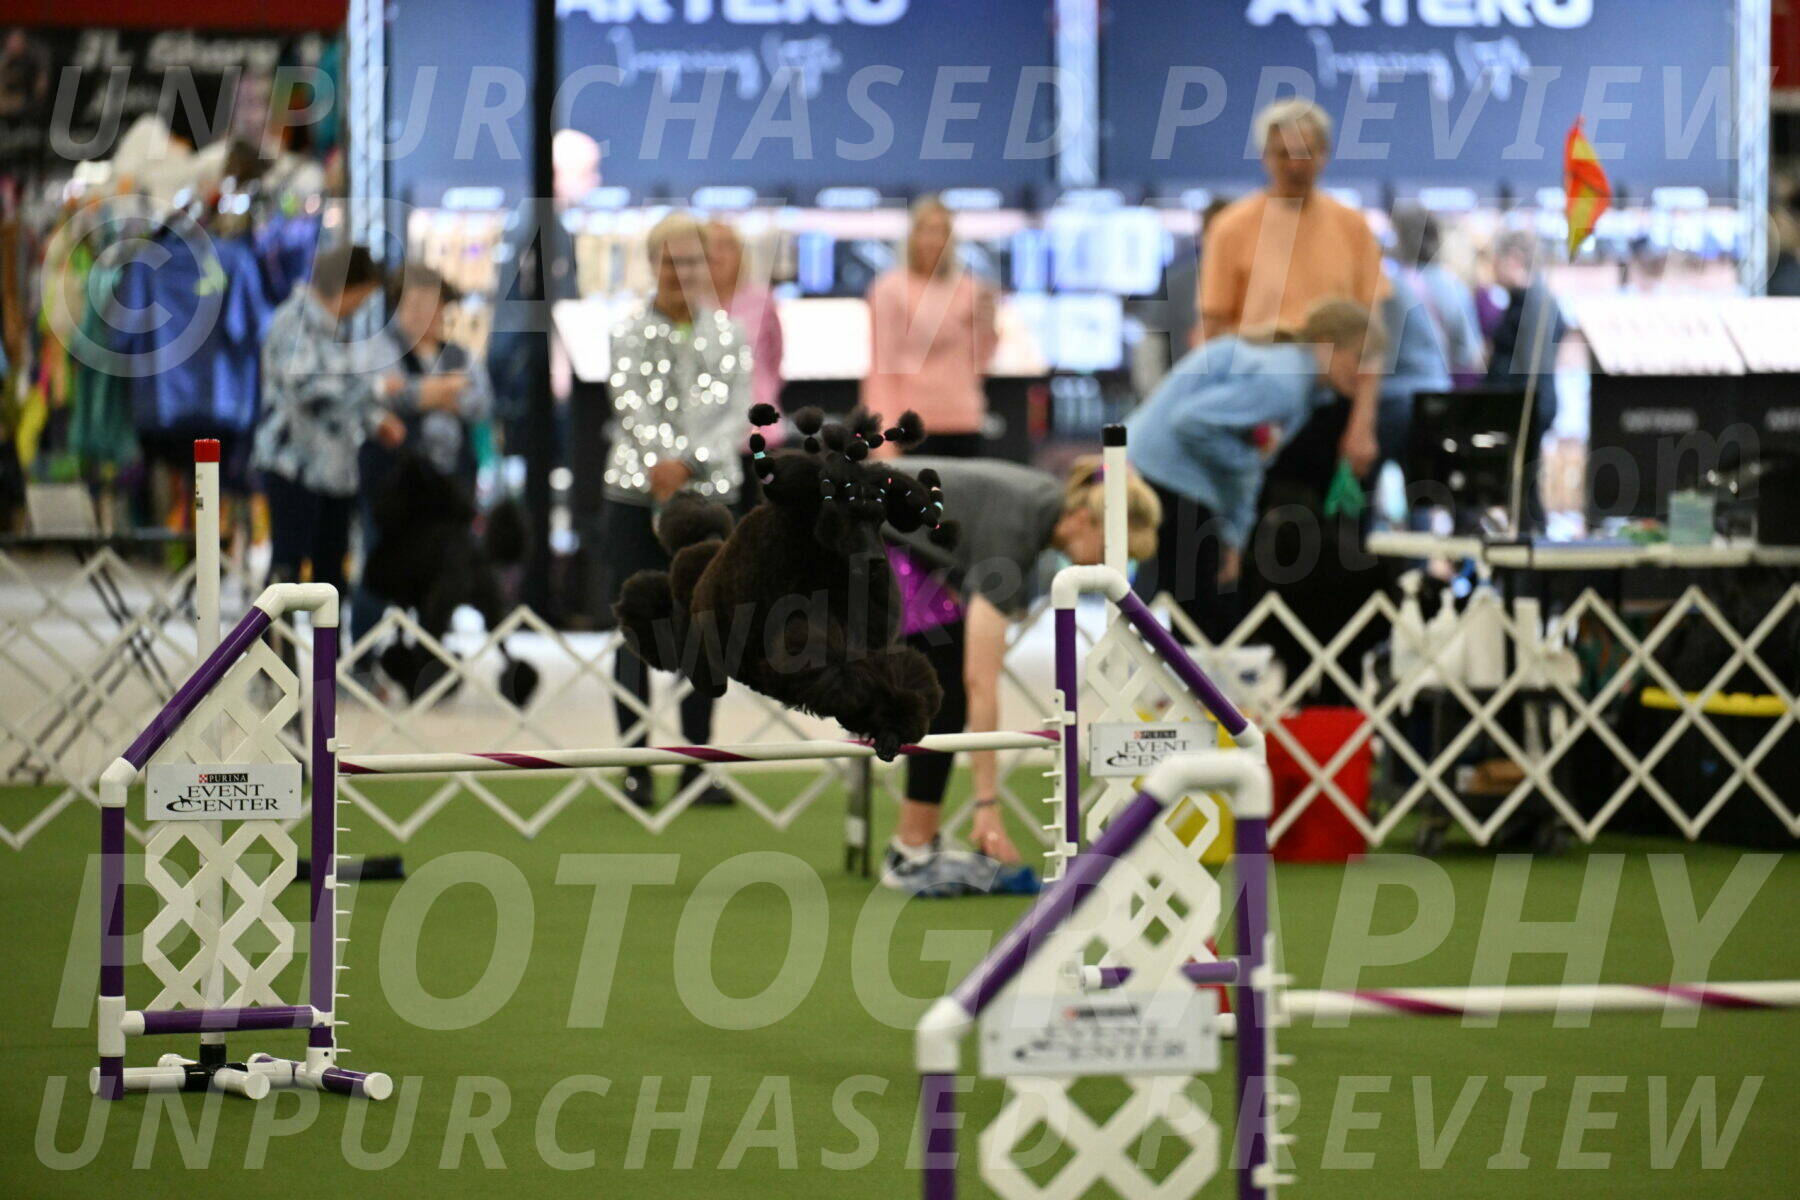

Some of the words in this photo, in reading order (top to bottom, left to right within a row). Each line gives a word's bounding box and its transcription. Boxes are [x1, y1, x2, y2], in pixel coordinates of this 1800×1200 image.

[1124, 740, 1189, 753] EVENT
[208, 774, 247, 783] PURINA
[187, 784, 264, 798] EVENT
[166, 797, 280, 813] CENTER
